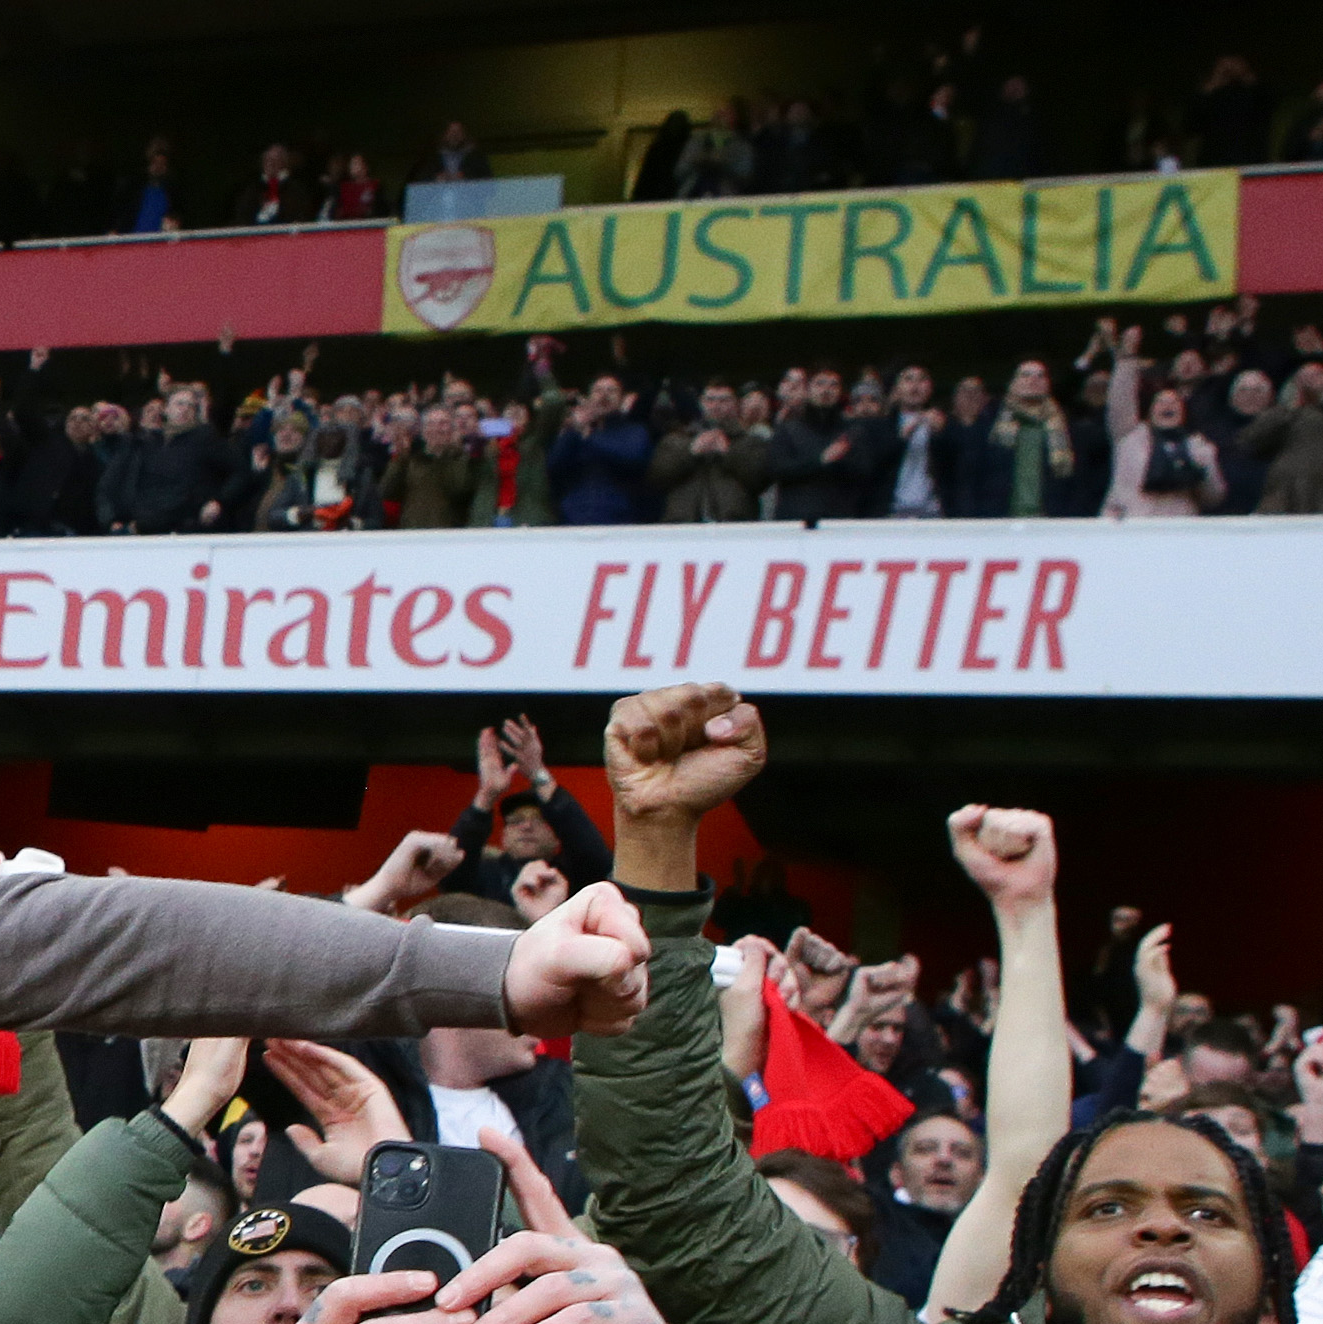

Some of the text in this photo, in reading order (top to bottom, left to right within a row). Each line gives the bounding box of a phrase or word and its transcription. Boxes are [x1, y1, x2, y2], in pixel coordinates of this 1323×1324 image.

[512, 184, 1219, 319] AUSTRALIA
[573, 561, 724, 671] FLY
[744, 558, 1082, 672] BETTER
